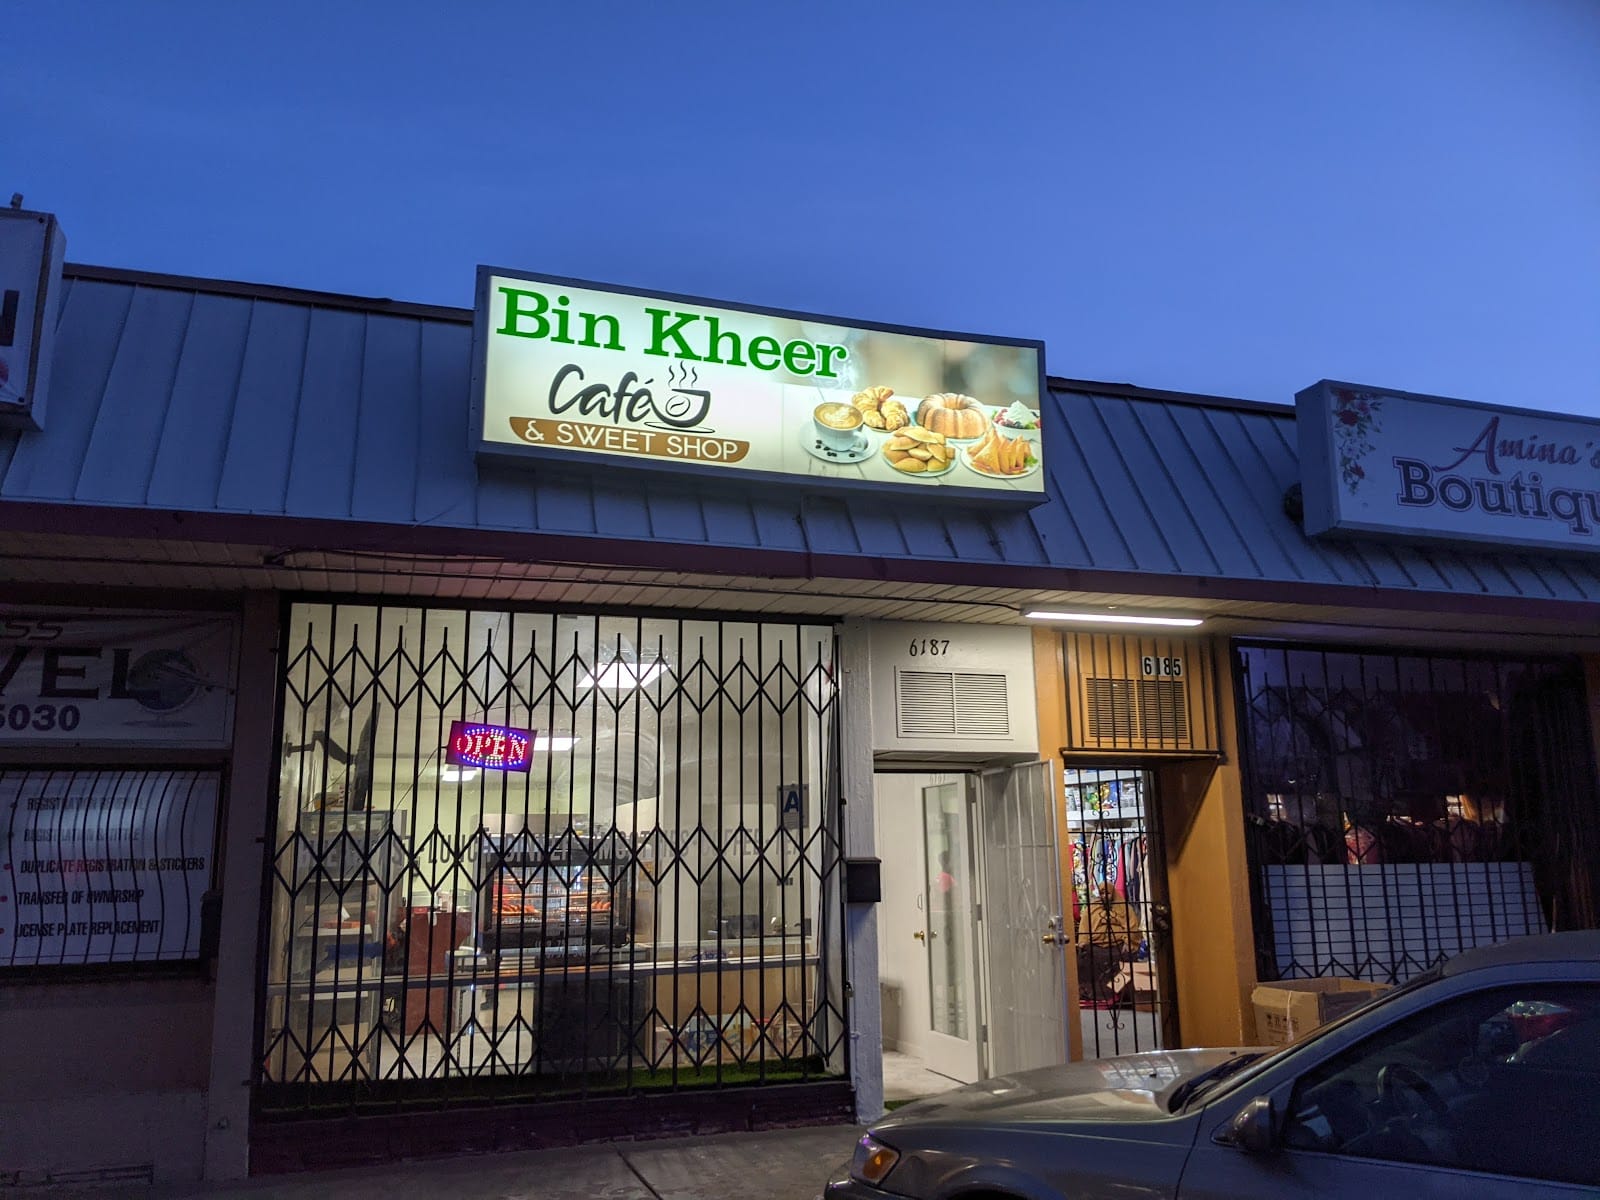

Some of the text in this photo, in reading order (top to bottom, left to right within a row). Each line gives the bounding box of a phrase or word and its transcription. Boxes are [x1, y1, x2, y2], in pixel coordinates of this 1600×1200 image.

[496, 286, 848, 378] Bin Kheer
[547, 363, 654, 424] Café
[524, 420, 739, 461] & SWEET SHOP
[908, 639, 951, 657] 6187
[1142, 656, 1182, 676] 6185
[0, 703, 81, 732] 030
[455, 732, 528, 760] OPEN
[783, 790, 801, 813] A
[20, 860, 75, 873] DUPLICATE
[148, 858, 160, 871] &
[159, 857, 206, 871] STICKERS
[18, 891, 69, 905] TRANSFER
[71, 891, 85, 904] OF
[57, 922, 88, 936] PLATE
